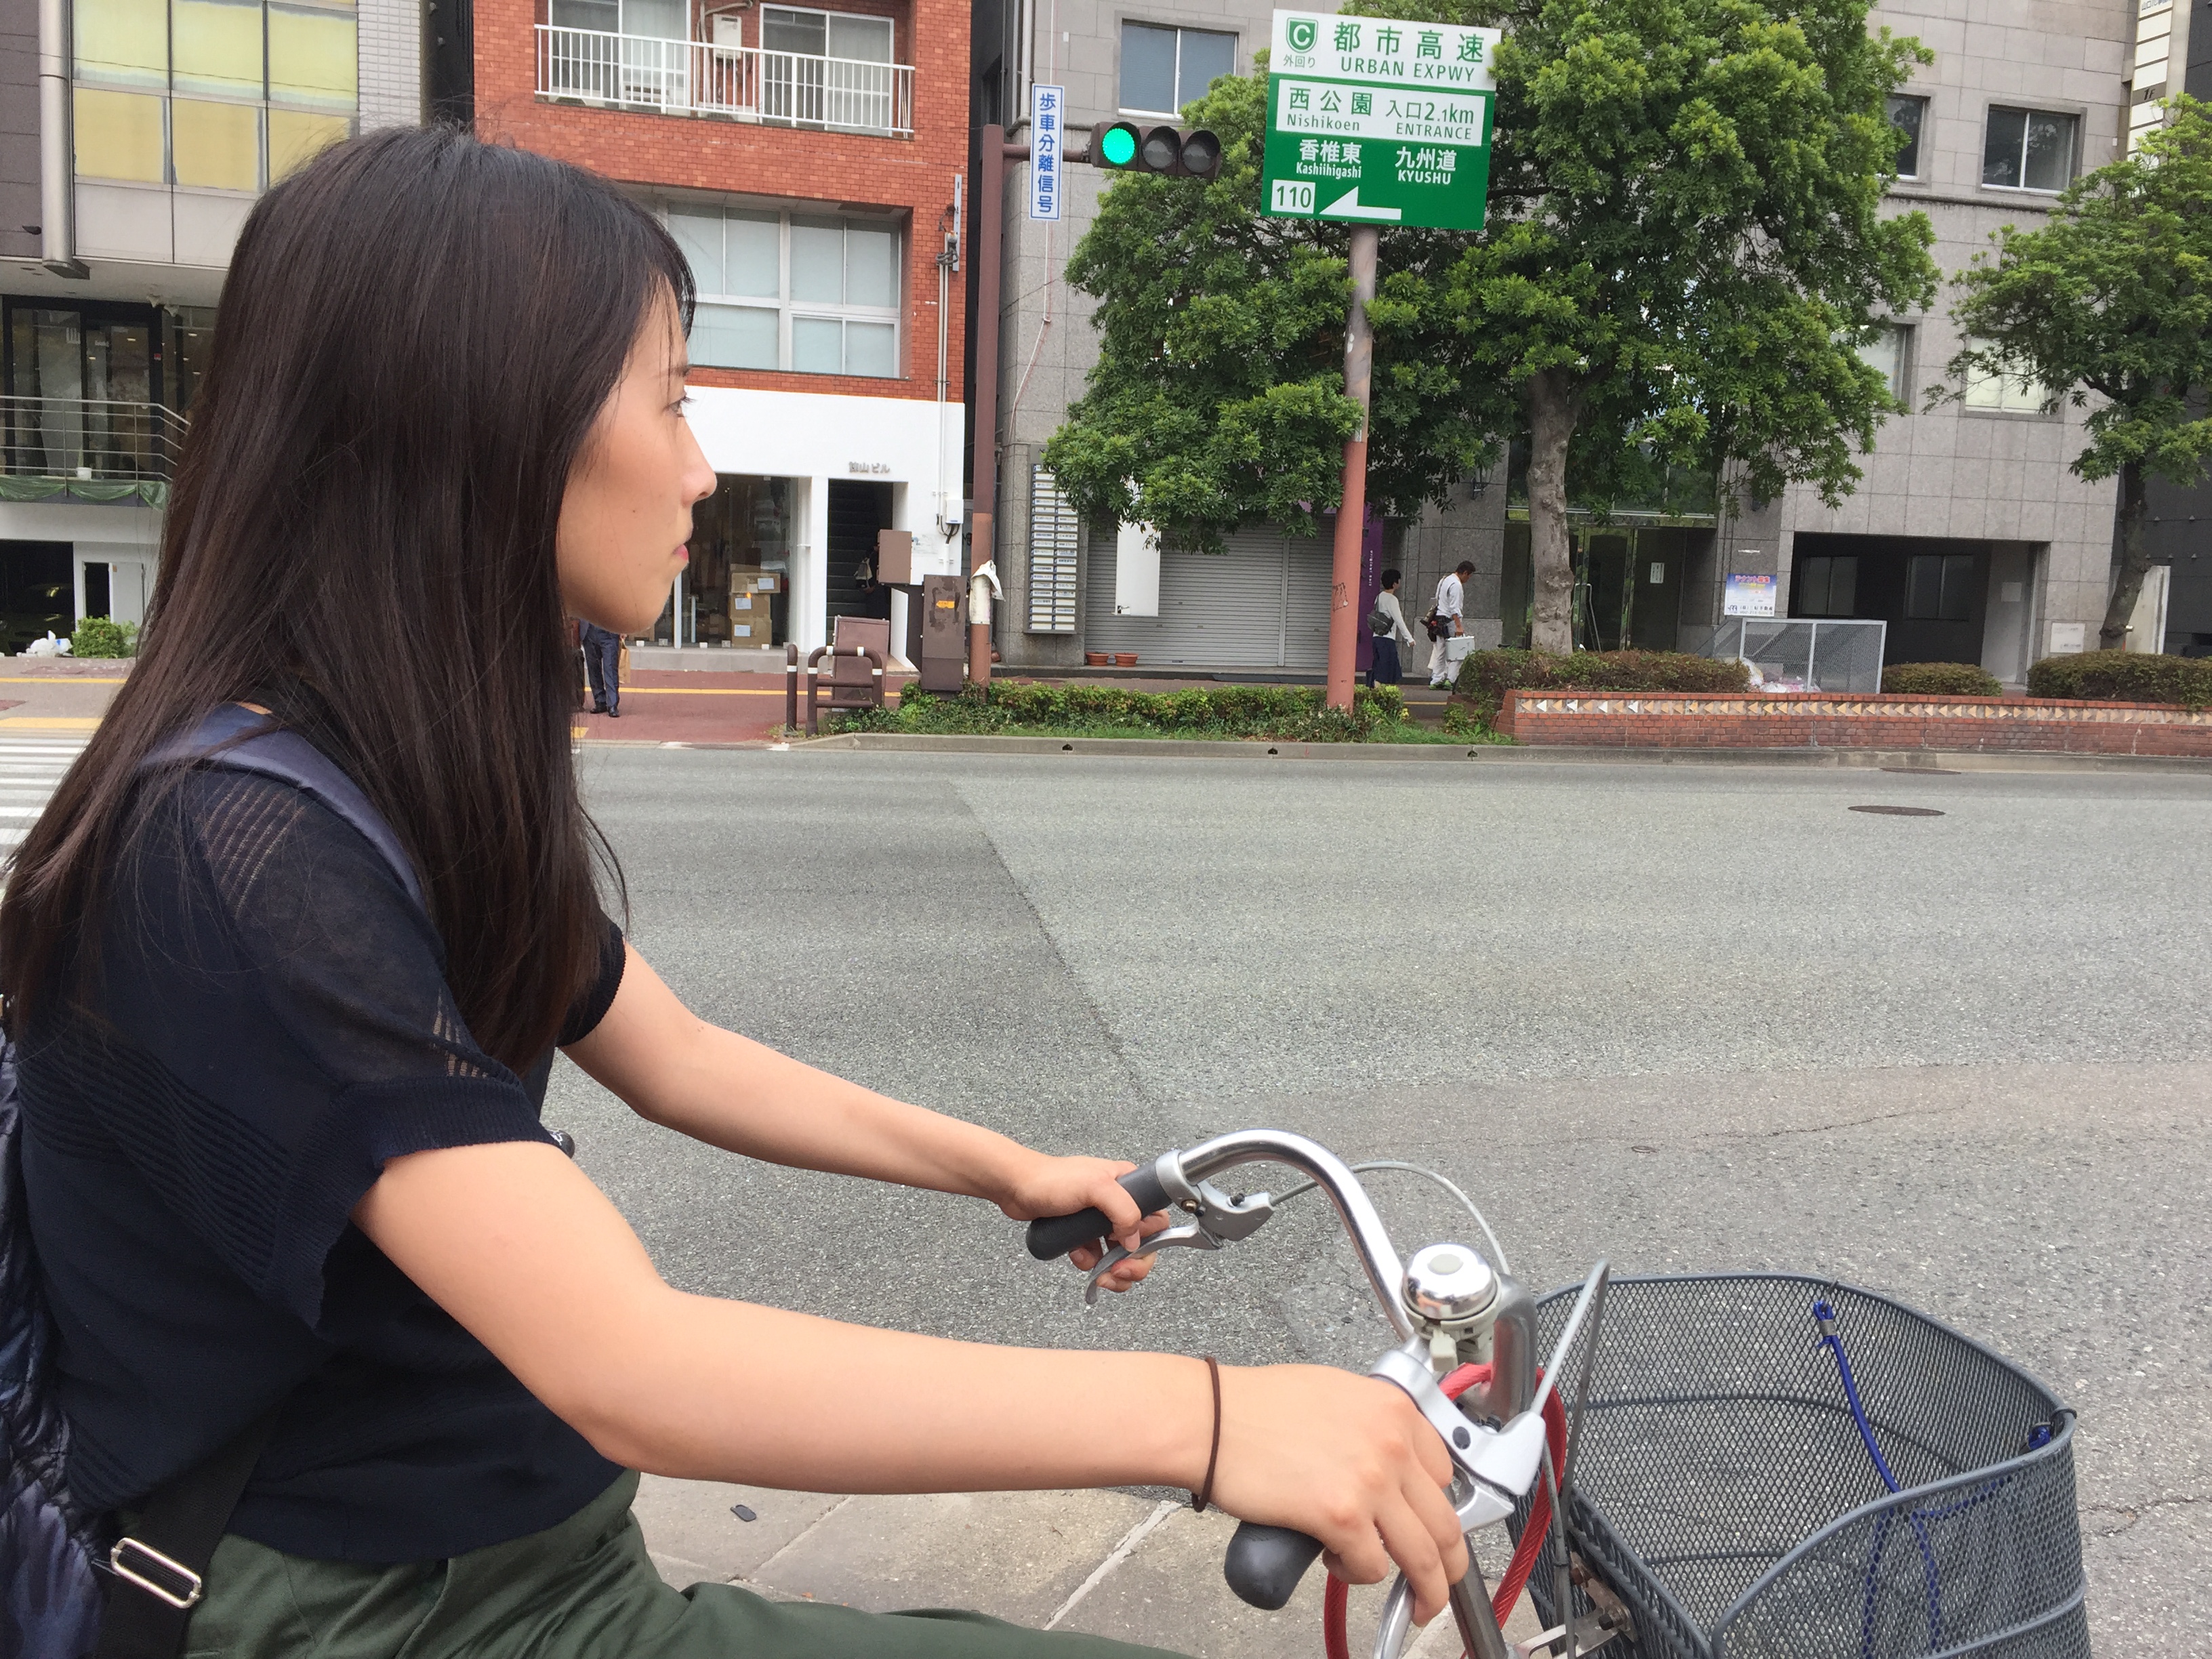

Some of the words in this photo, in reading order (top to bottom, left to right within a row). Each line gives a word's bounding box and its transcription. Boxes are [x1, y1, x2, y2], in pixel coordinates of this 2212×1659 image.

[1333, 21, 1485, 63] 都市高速
[1283, 54, 1316, 68] 外回り
[1340, 56, 1404, 76] URBAN
[1414, 63, 1475, 82] EXPWY
[1289, 87, 1373, 117] 西公園
[2144, 88, 2156, 100] 1F
[1287, 114, 1360, 131] Nishikoen
[1396, 122, 1472, 140] ENTRANCE
[1037, 92, 1057, 213] 歩車分離信号
[1298, 138, 1362, 165] 香椎東
[1395, 146, 1457, 171] 九州道
[1296, 162, 1362, 180] Kashiihigashi
[1397, 169, 1452, 185] KYUSHU
[1276, 185, 1312, 209] 110
